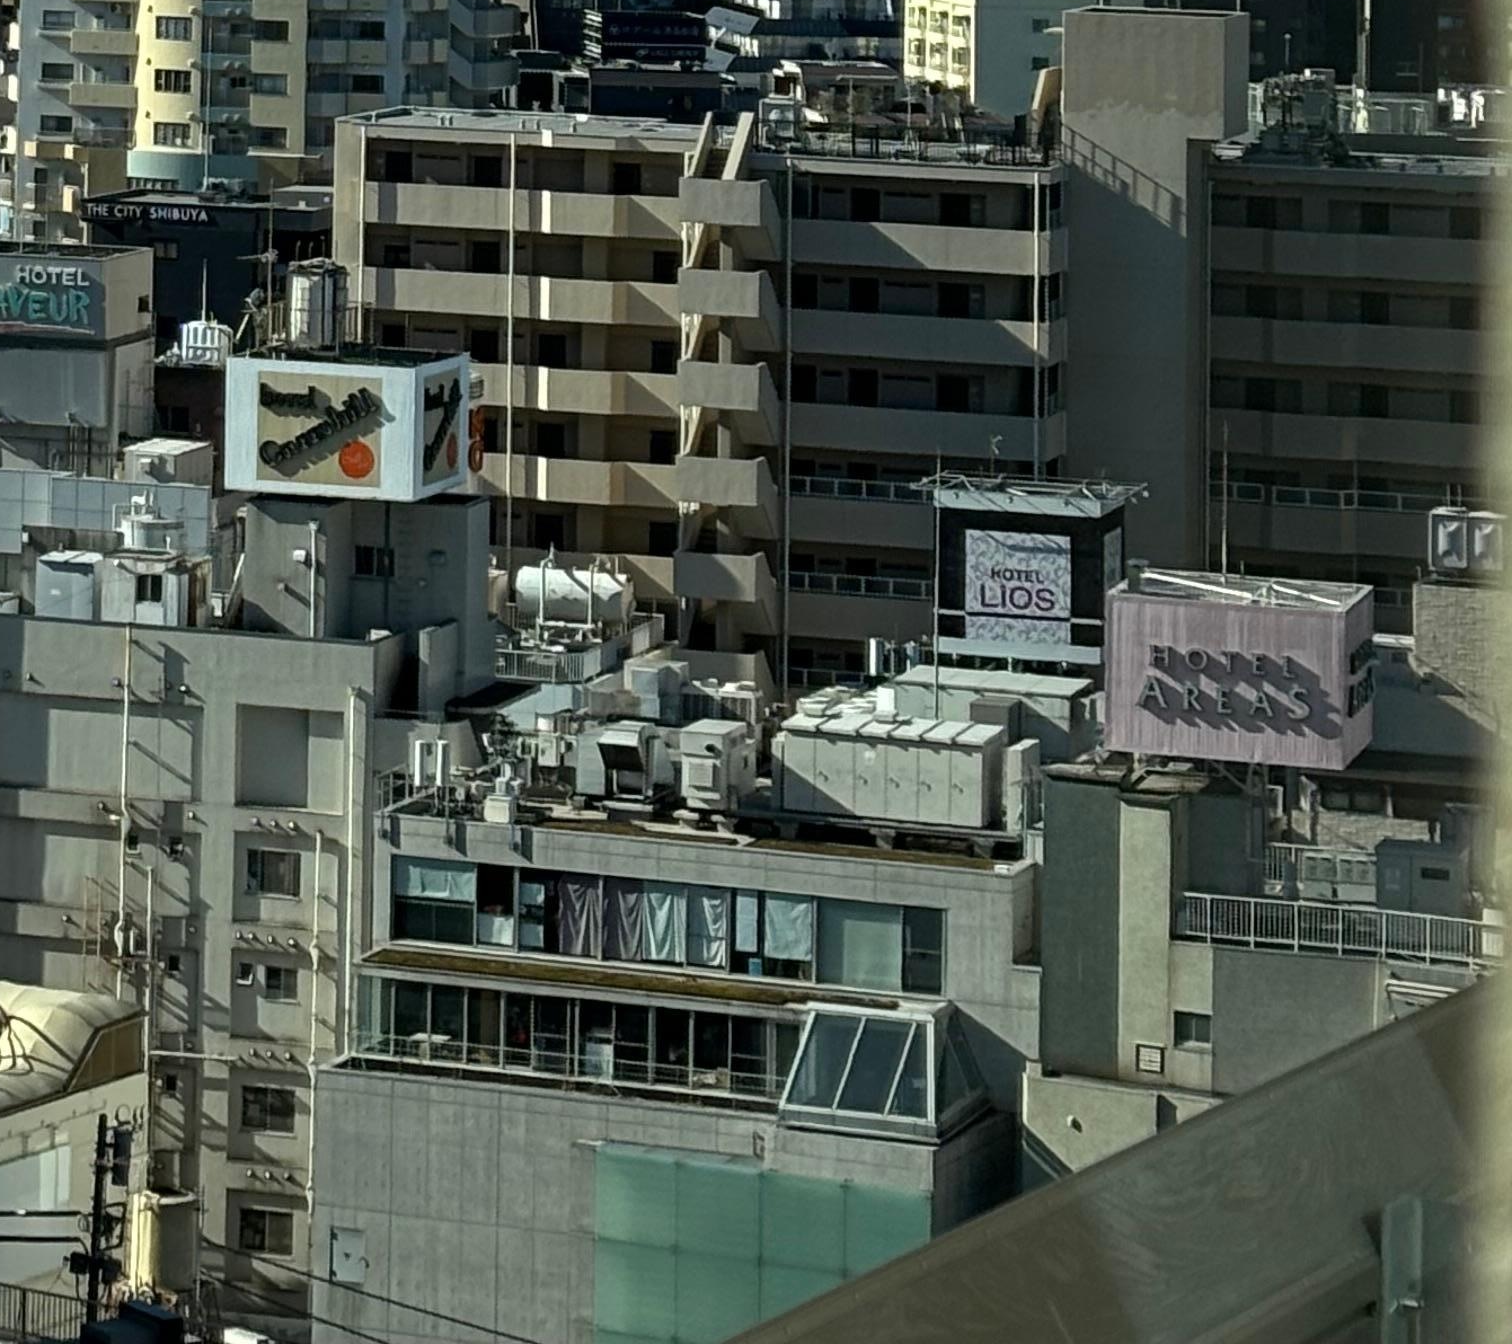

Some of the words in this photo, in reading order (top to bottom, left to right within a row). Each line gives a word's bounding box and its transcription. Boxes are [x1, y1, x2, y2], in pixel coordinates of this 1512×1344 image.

[87, 203, 109, 217] THE
[114, 205, 144, 218] CITY
[149, 207, 209, 223] SHIBUYA
[15, 264, 90, 287] HOTEL
[990, 567, 1045, 584] HOTEL
[1148, 643, 1296, 679] HOTEL
[1138, 673, 1311, 720] AREAS
